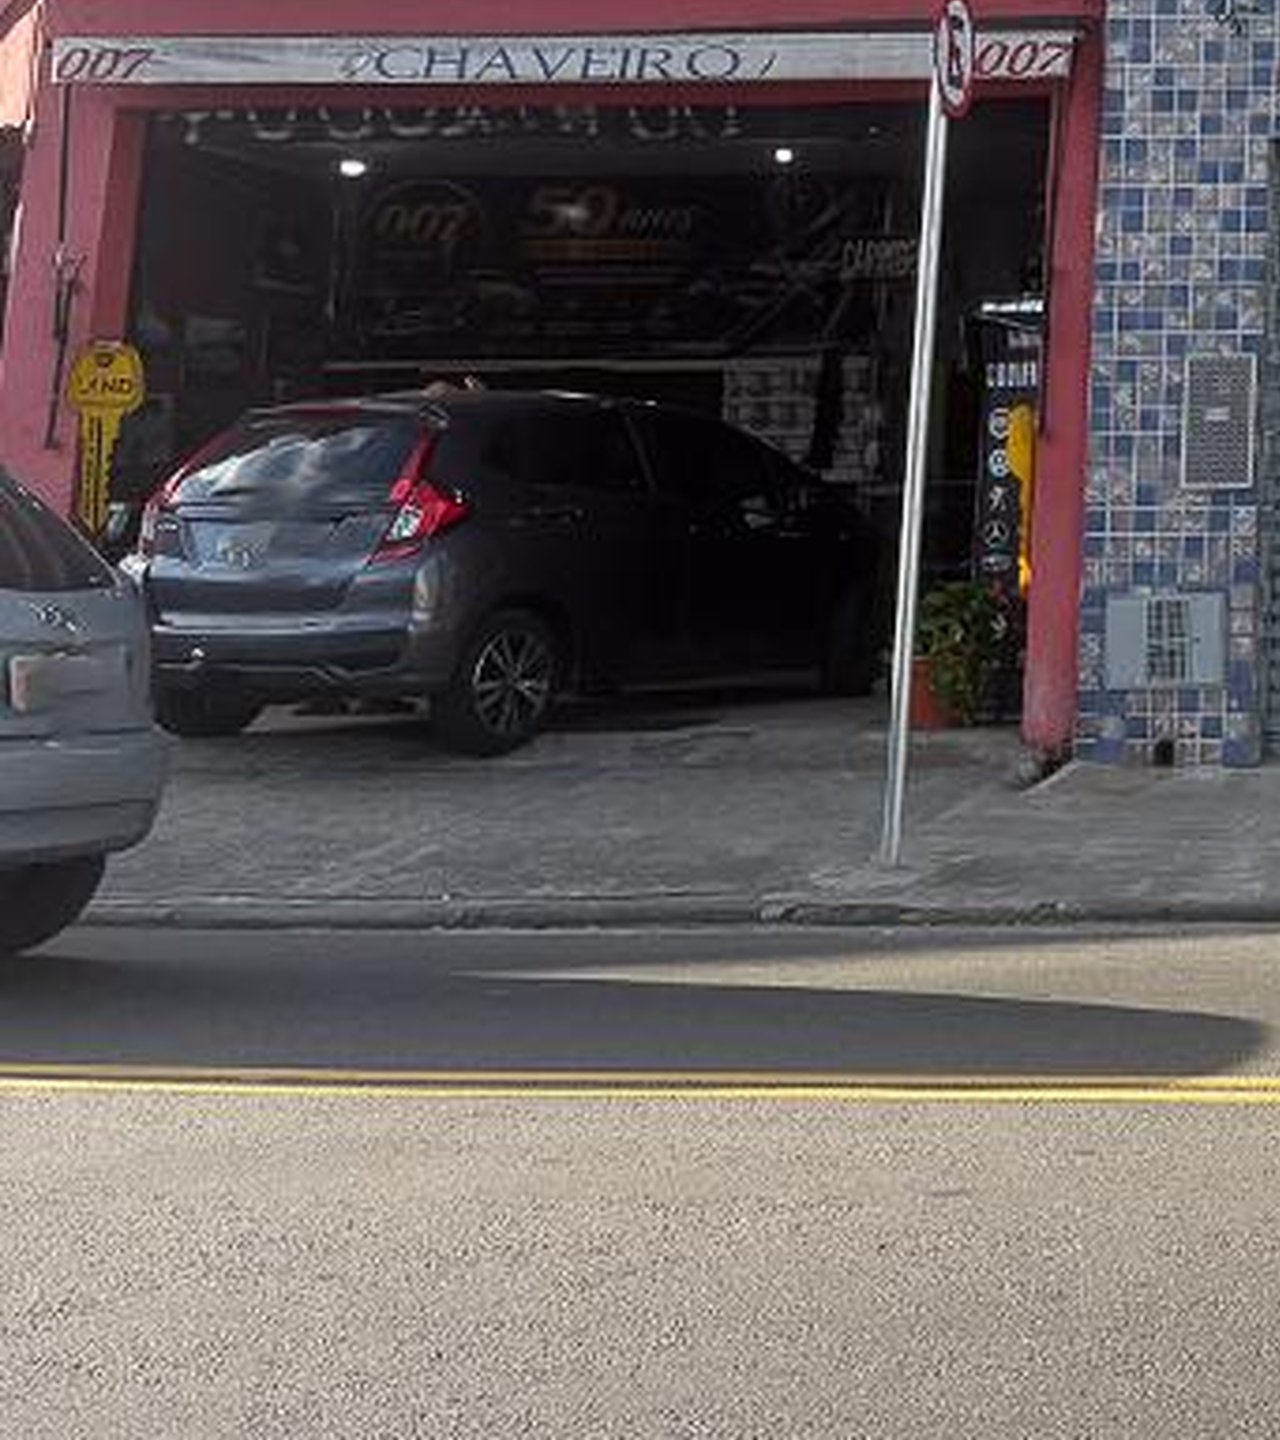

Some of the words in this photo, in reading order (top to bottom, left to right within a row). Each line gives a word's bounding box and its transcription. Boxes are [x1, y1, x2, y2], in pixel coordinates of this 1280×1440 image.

[56, 47, 155, 80] 007
[376, 44, 741, 80] CHAVEIRO
[979, 41, 1071, 76] 007
